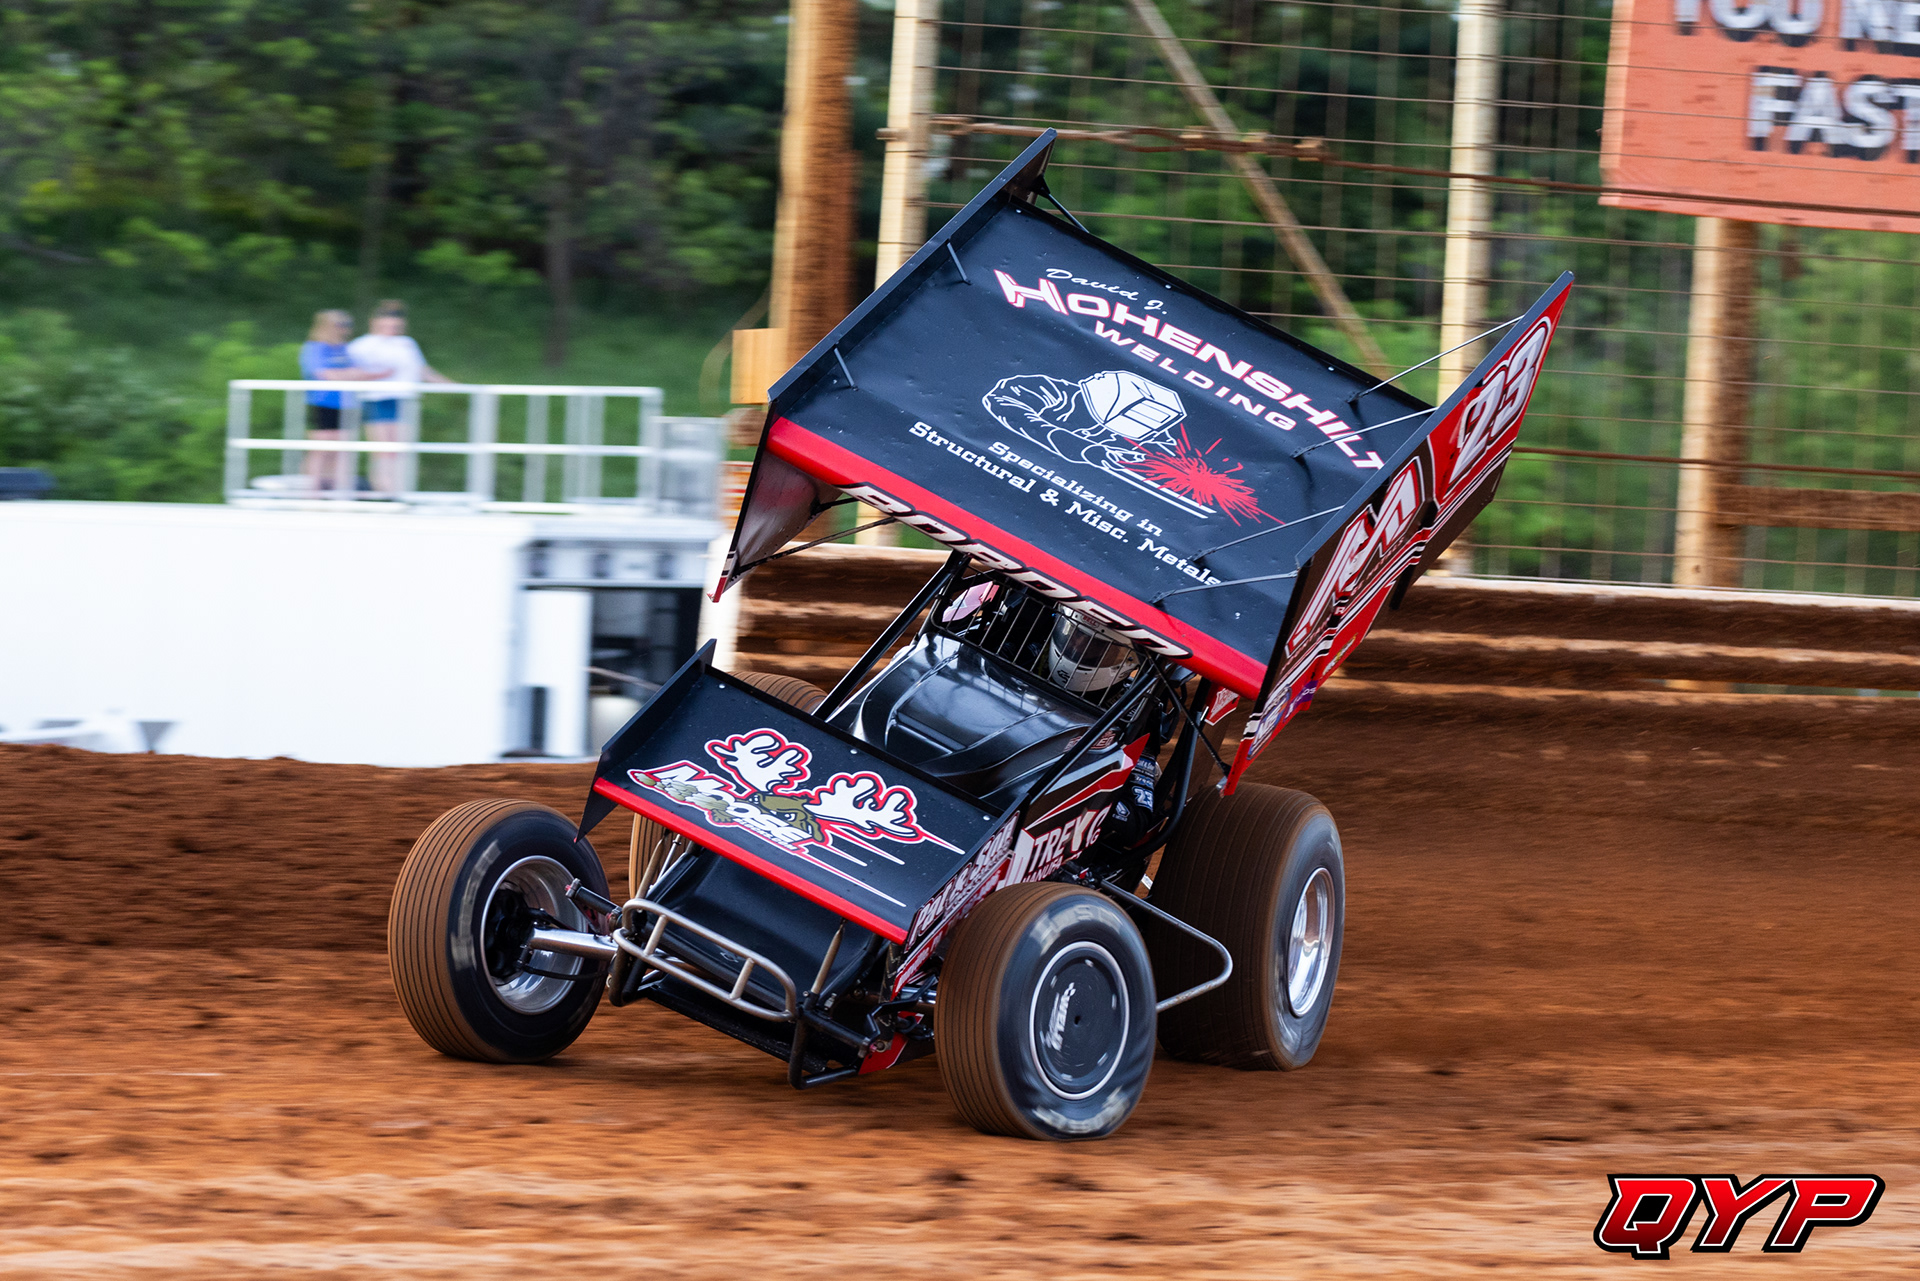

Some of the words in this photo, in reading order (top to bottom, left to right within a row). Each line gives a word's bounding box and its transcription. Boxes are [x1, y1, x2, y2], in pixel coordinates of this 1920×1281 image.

[1046, 268, 1139, 301] David
[1144, 300, 1168, 315] J.
[994, 269, 1385, 471] HOHENSHILT
[1094, 320, 1297, 431] WELDING
[1446, 318, 1551, 495] 23
[909, 420, 1039, 493] Structural
[1039, 489, 1060, 507] &
[1065, 501, 1130, 543] Misc.
[1137, 538, 1222, 586] Metals
[988, 441, 1134, 521] Specializing
[1137, 519, 1163, 537] in
